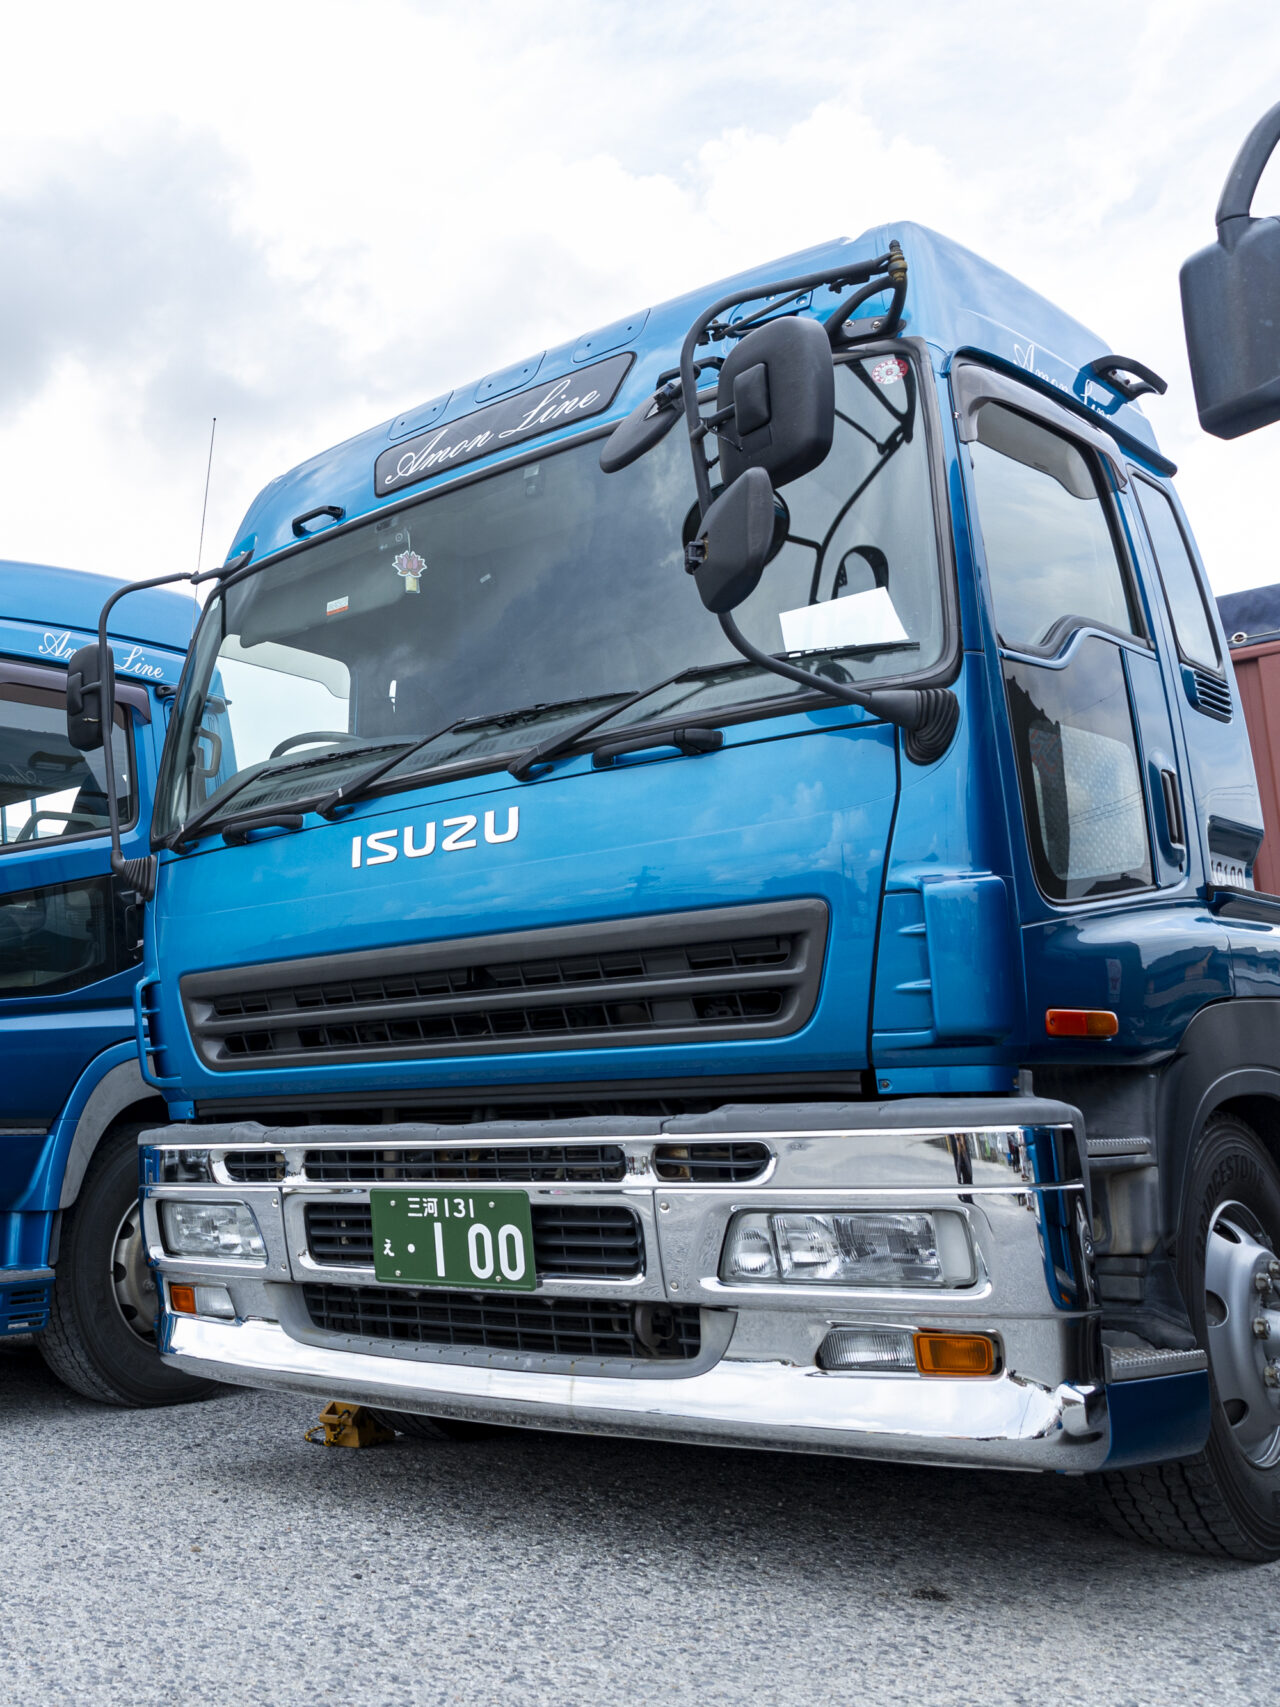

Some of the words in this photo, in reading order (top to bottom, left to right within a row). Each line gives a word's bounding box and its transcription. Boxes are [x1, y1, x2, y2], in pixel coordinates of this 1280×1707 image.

[384, 428, 494, 484] Amon
[498, 379, 600, 439] Line
[113, 645, 164, 678] Line
[352, 806, 519, 869] ISUZU
